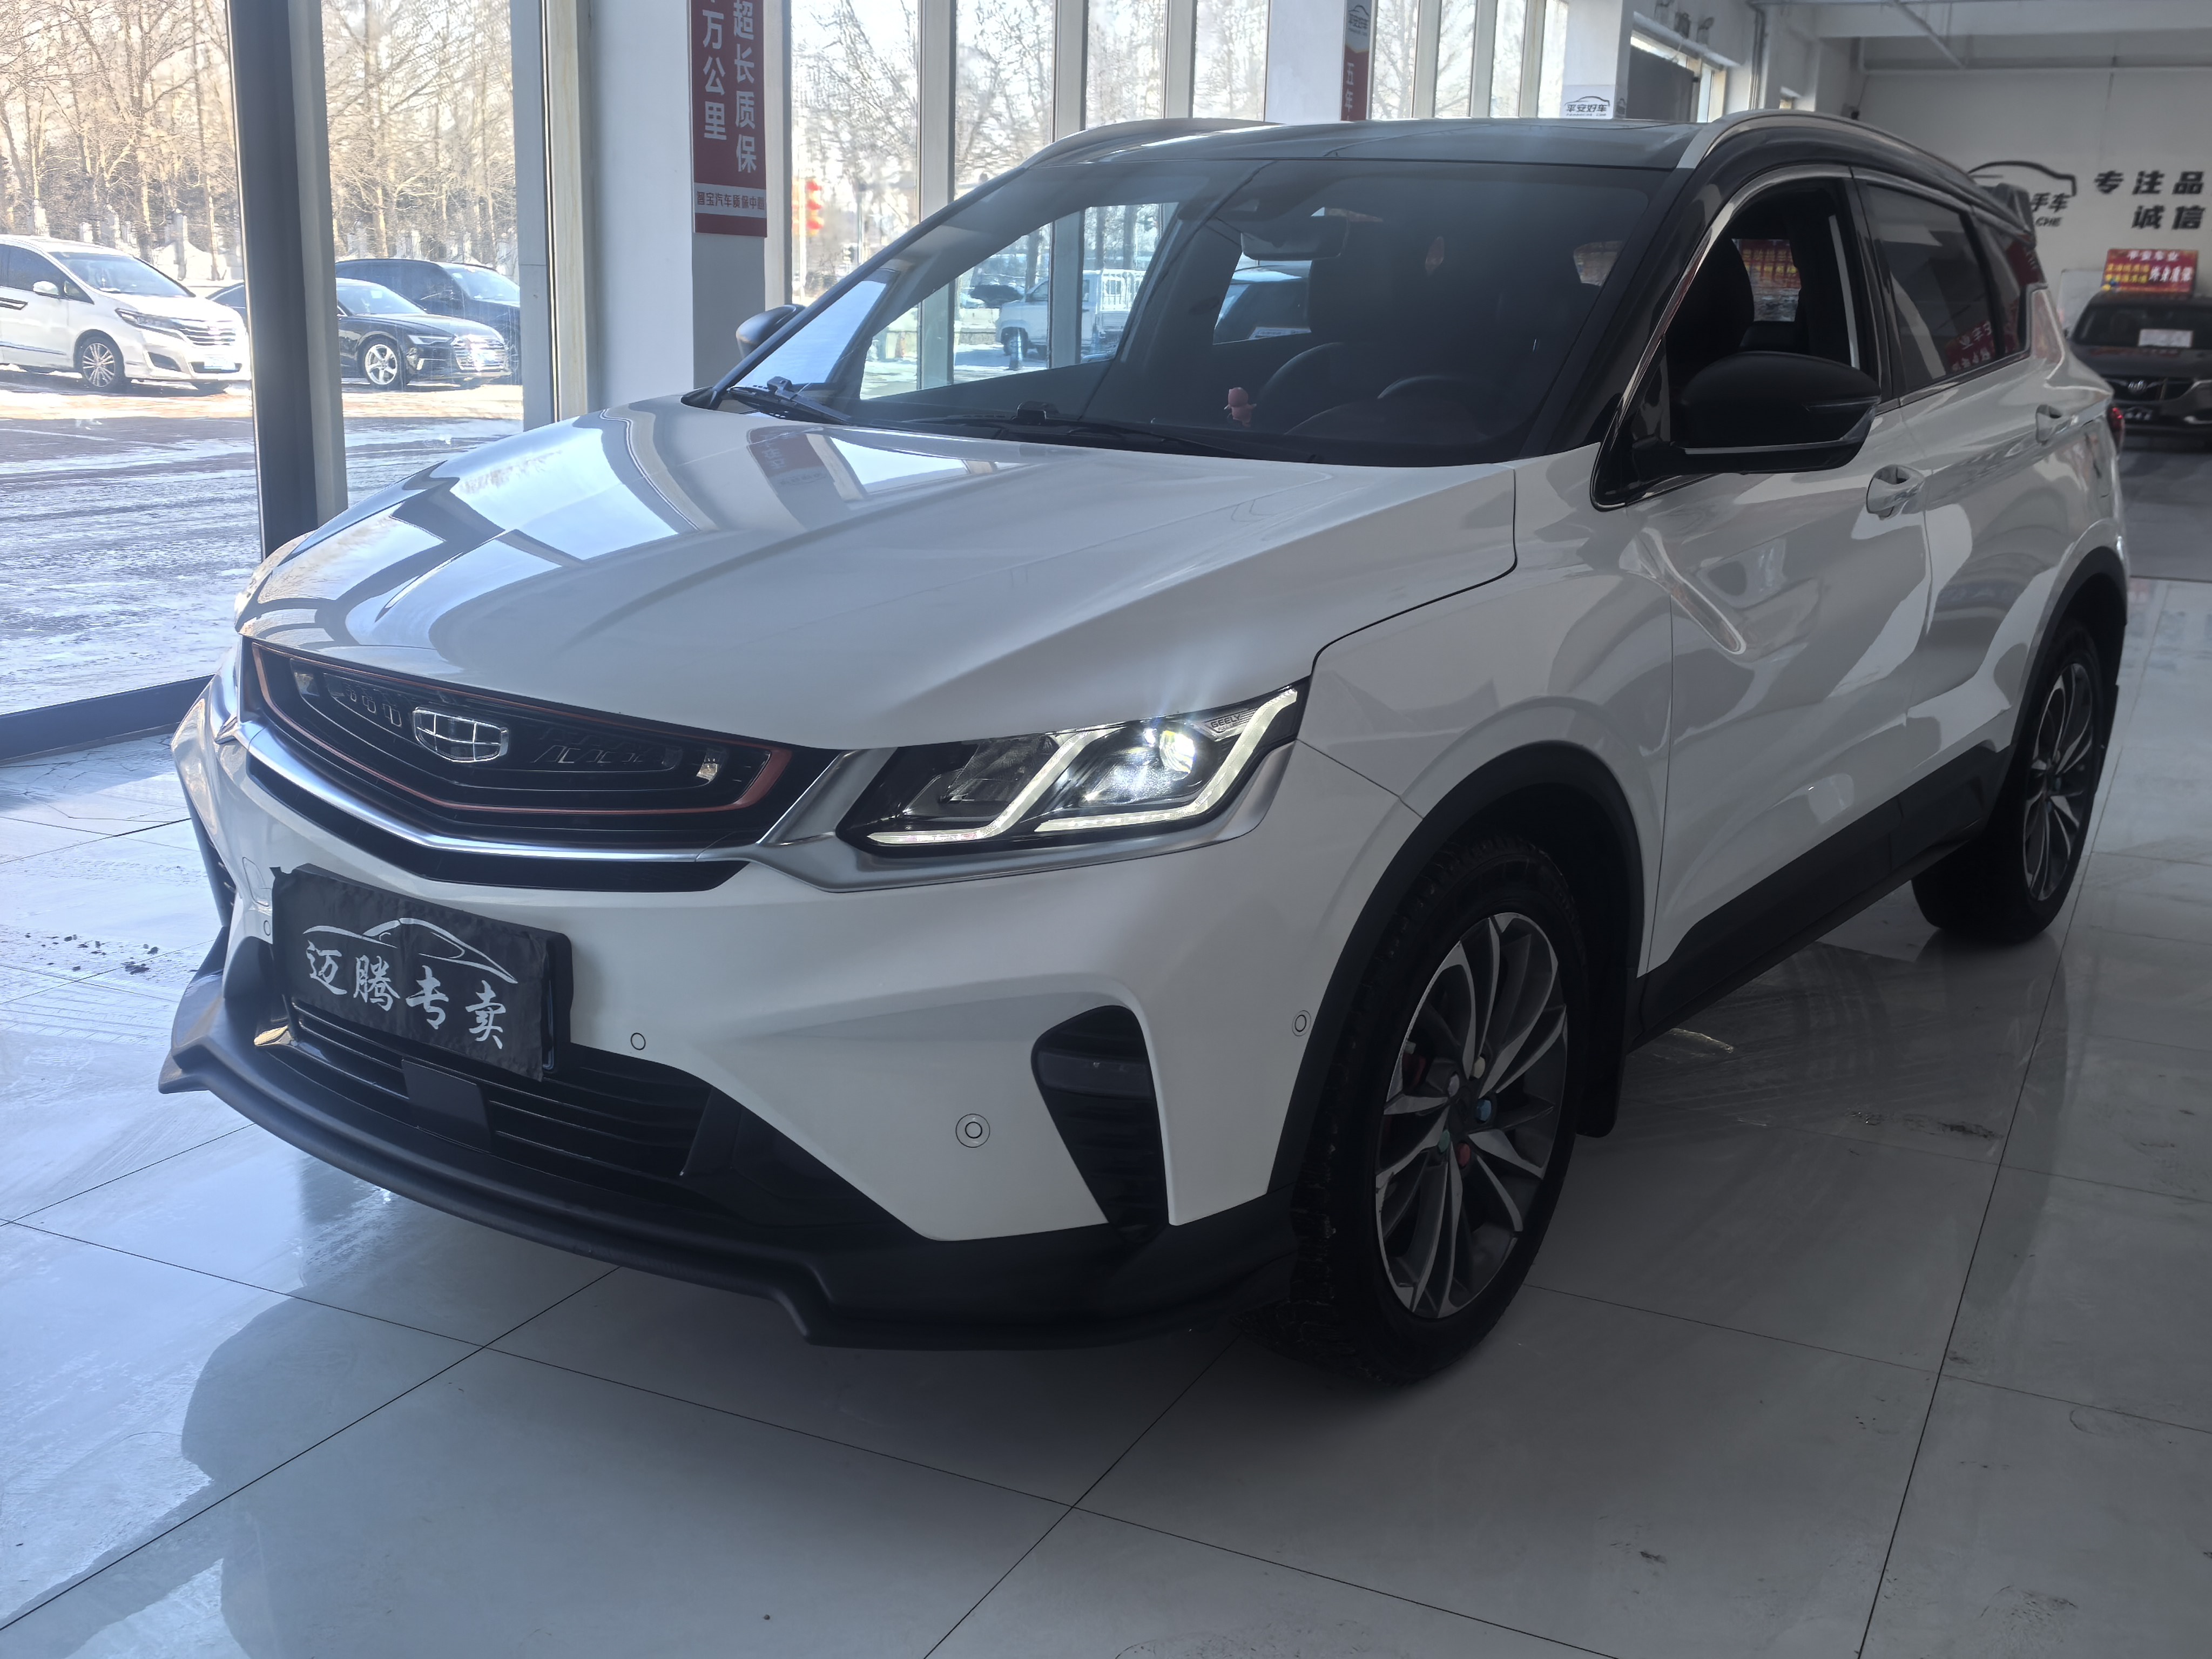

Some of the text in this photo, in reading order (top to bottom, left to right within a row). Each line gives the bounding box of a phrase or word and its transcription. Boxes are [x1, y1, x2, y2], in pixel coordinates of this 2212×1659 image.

[702, 0, 727, 140] 万公里
[733, 0, 757, 173] 超长质保
[2094, 170, 2204, 195] 专注品
[2131, 204, 2206, 231] 诚信
[1210, 714, 1241, 728] GEELY
[305, 940, 506, 1049] 迈腾专卖
